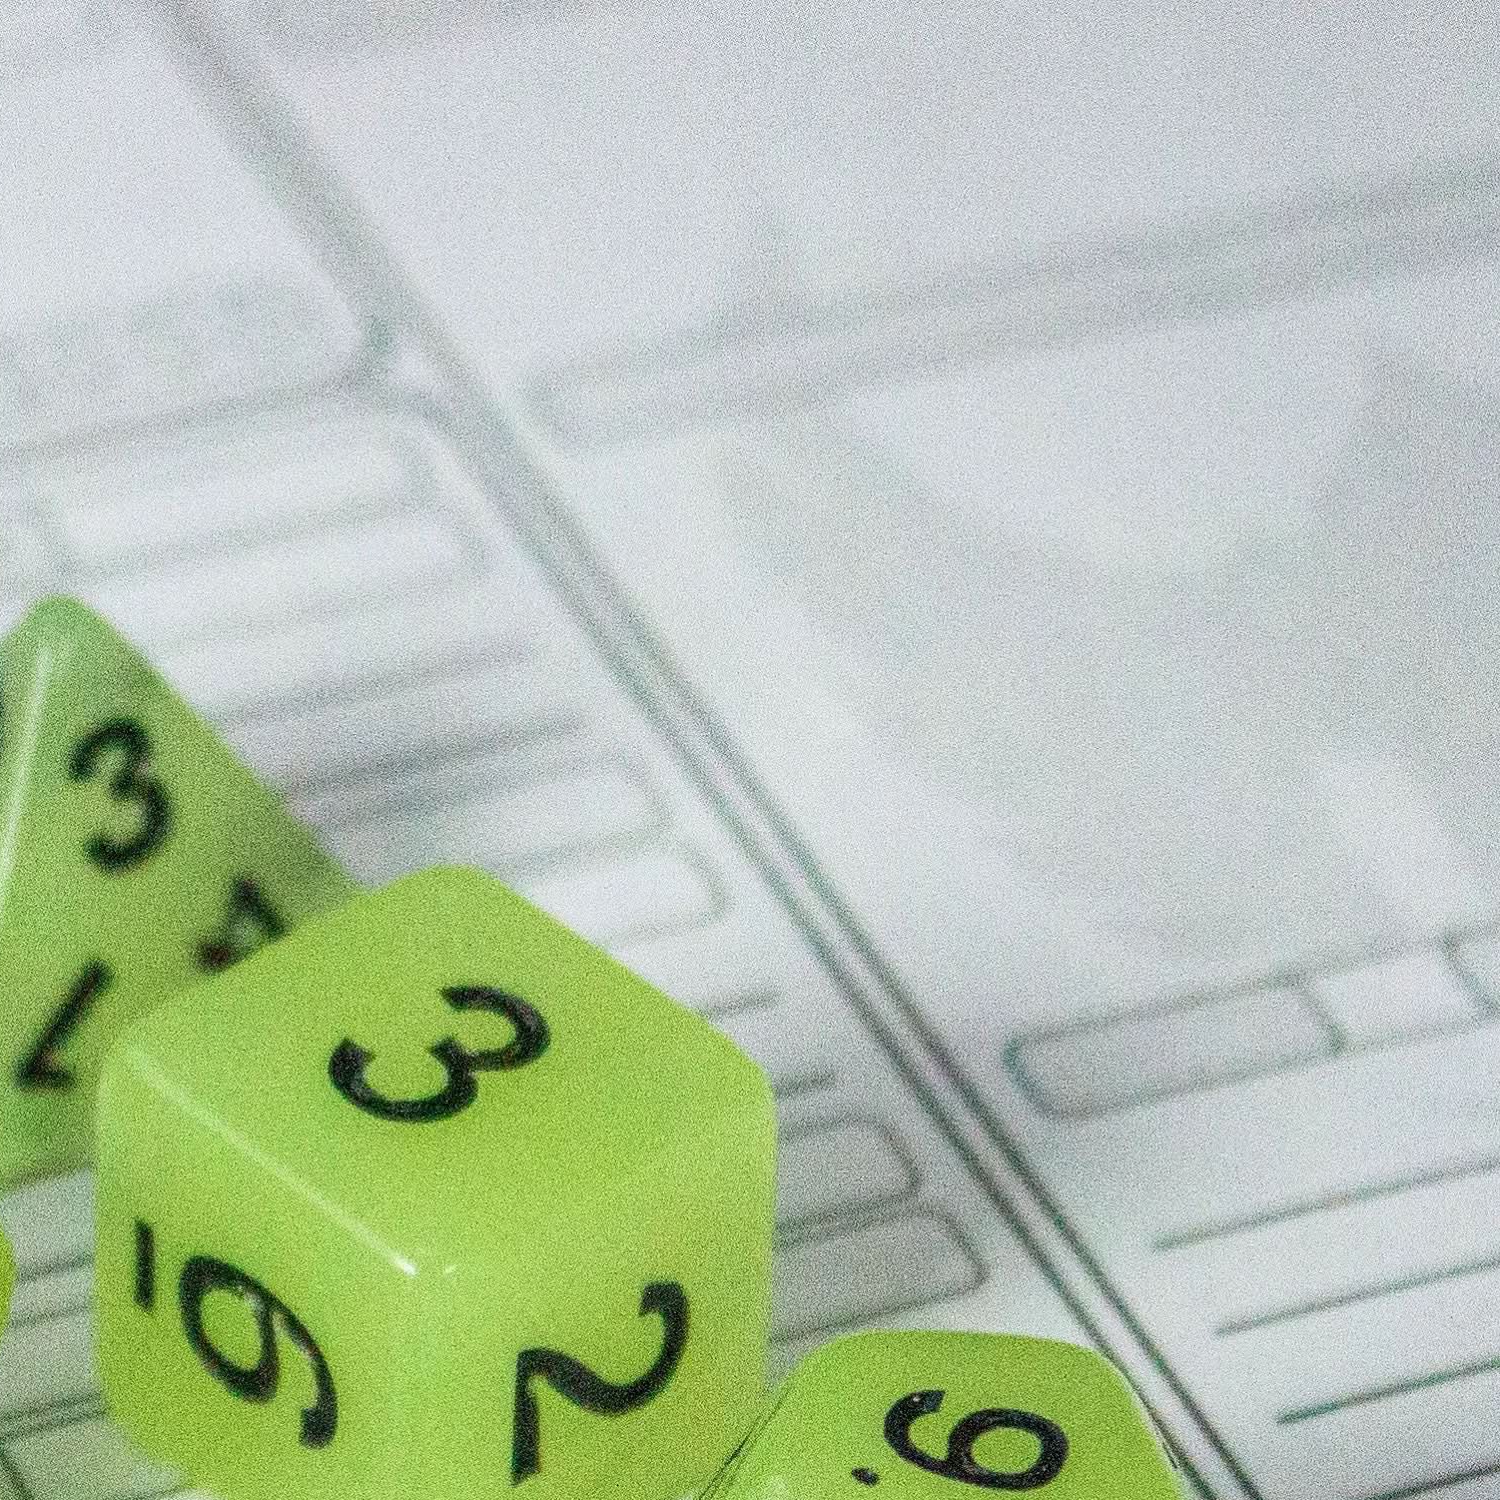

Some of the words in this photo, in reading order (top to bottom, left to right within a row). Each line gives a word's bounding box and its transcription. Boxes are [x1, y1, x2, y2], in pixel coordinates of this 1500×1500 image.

[67, 715, 174, 876] 3
[326, 984, 552, 1124] 3
[509, 1279, 692, 1487] 2
